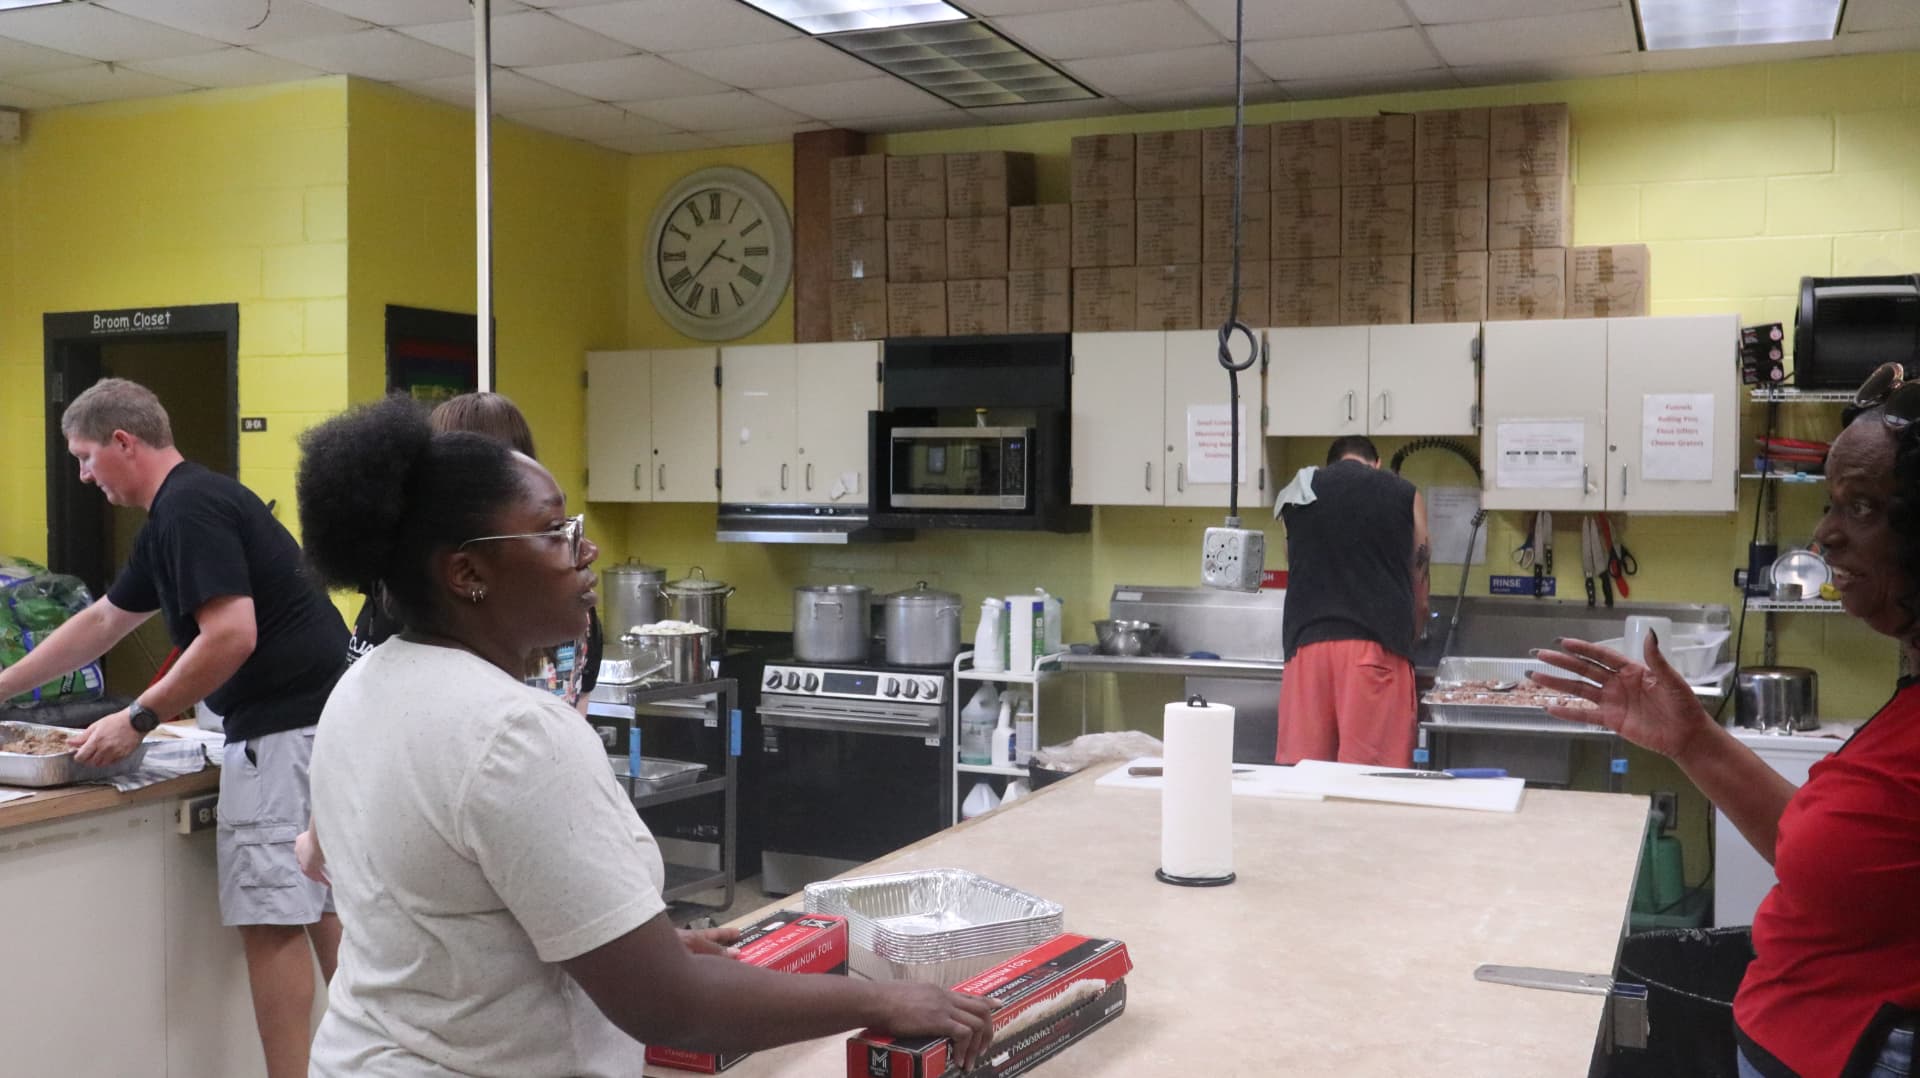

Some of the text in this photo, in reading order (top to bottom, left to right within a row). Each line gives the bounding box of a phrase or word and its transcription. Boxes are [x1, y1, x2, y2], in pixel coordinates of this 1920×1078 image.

[93, 310, 171, 330] Broom Closet
[1493, 578, 1521, 588] RINSE
[818, 939, 833, 956] FOIL
[963, 966, 1011, 993] ALUMINUM
